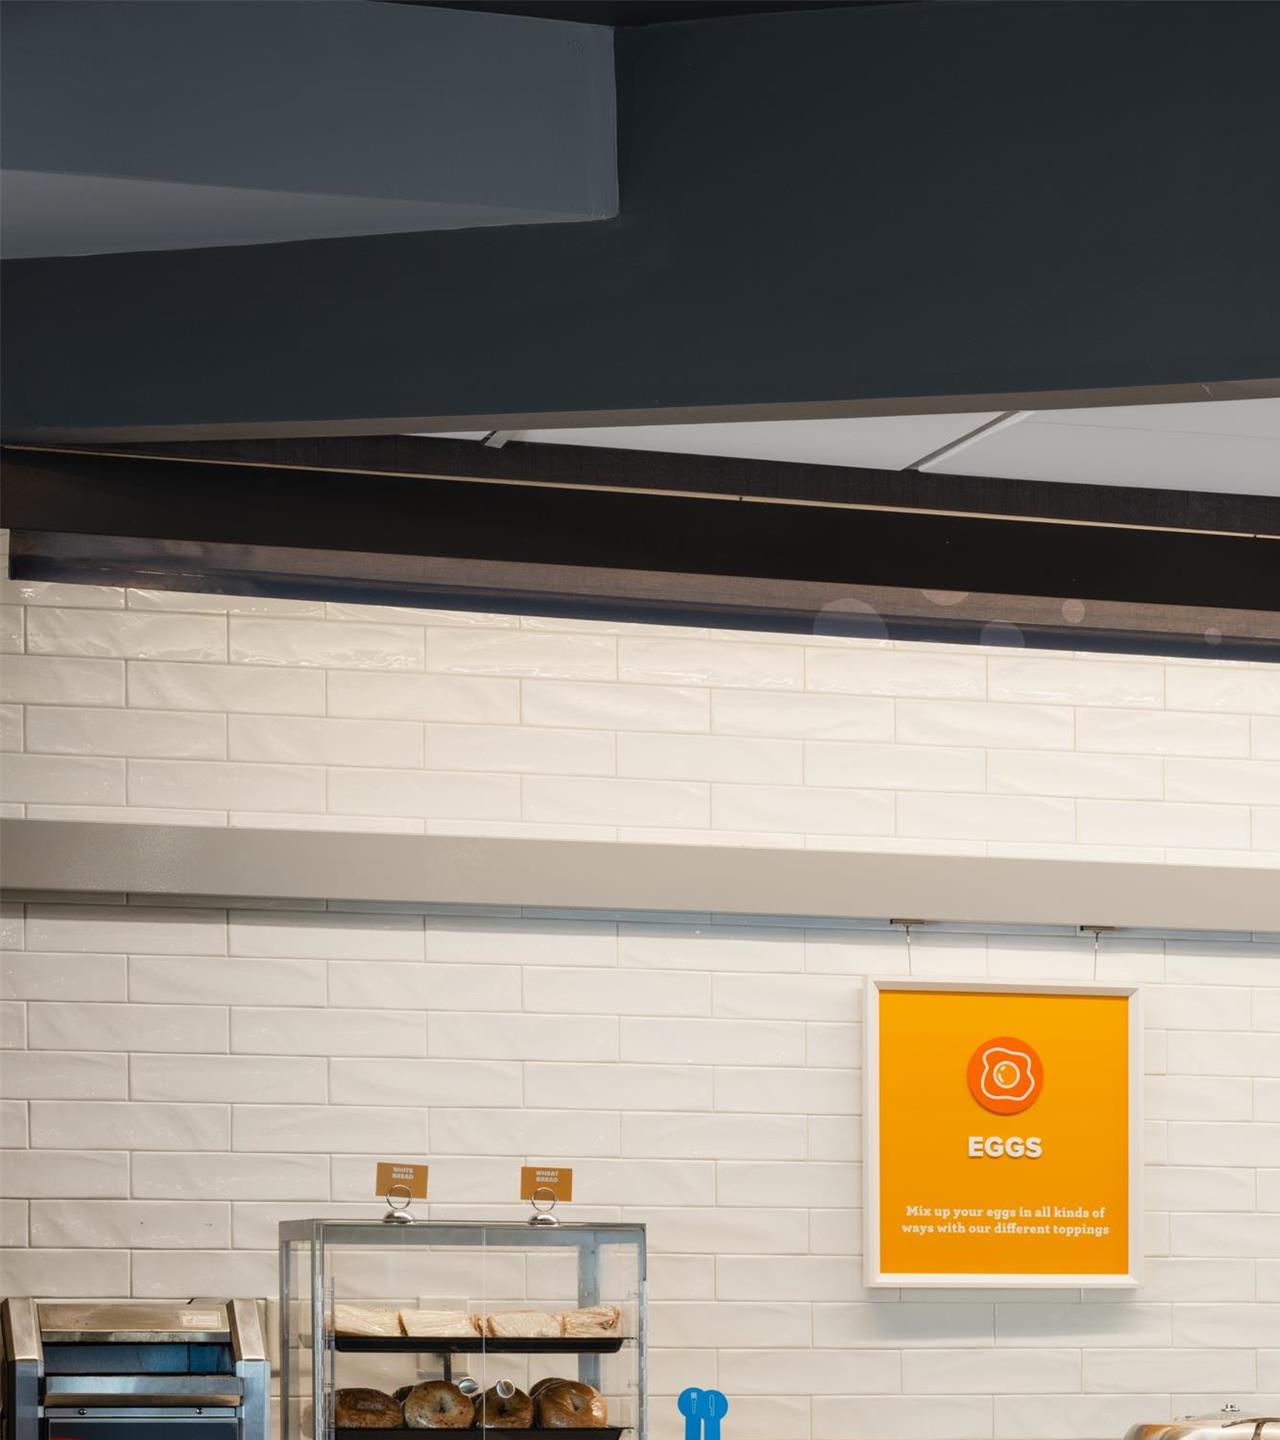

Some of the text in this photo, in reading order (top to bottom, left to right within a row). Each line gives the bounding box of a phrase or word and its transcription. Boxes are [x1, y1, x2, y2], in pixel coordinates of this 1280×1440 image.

[967, 1135, 1043, 1158] EGGS
[392, 1166, 414, 1174] WHITE
[535, 1169, 559, 1177] WHEAT
[905, 1205, 1106, 1220] Mix up your eggs in all kinds of
[901, 1222, 1110, 1238] ways with our different toppings
